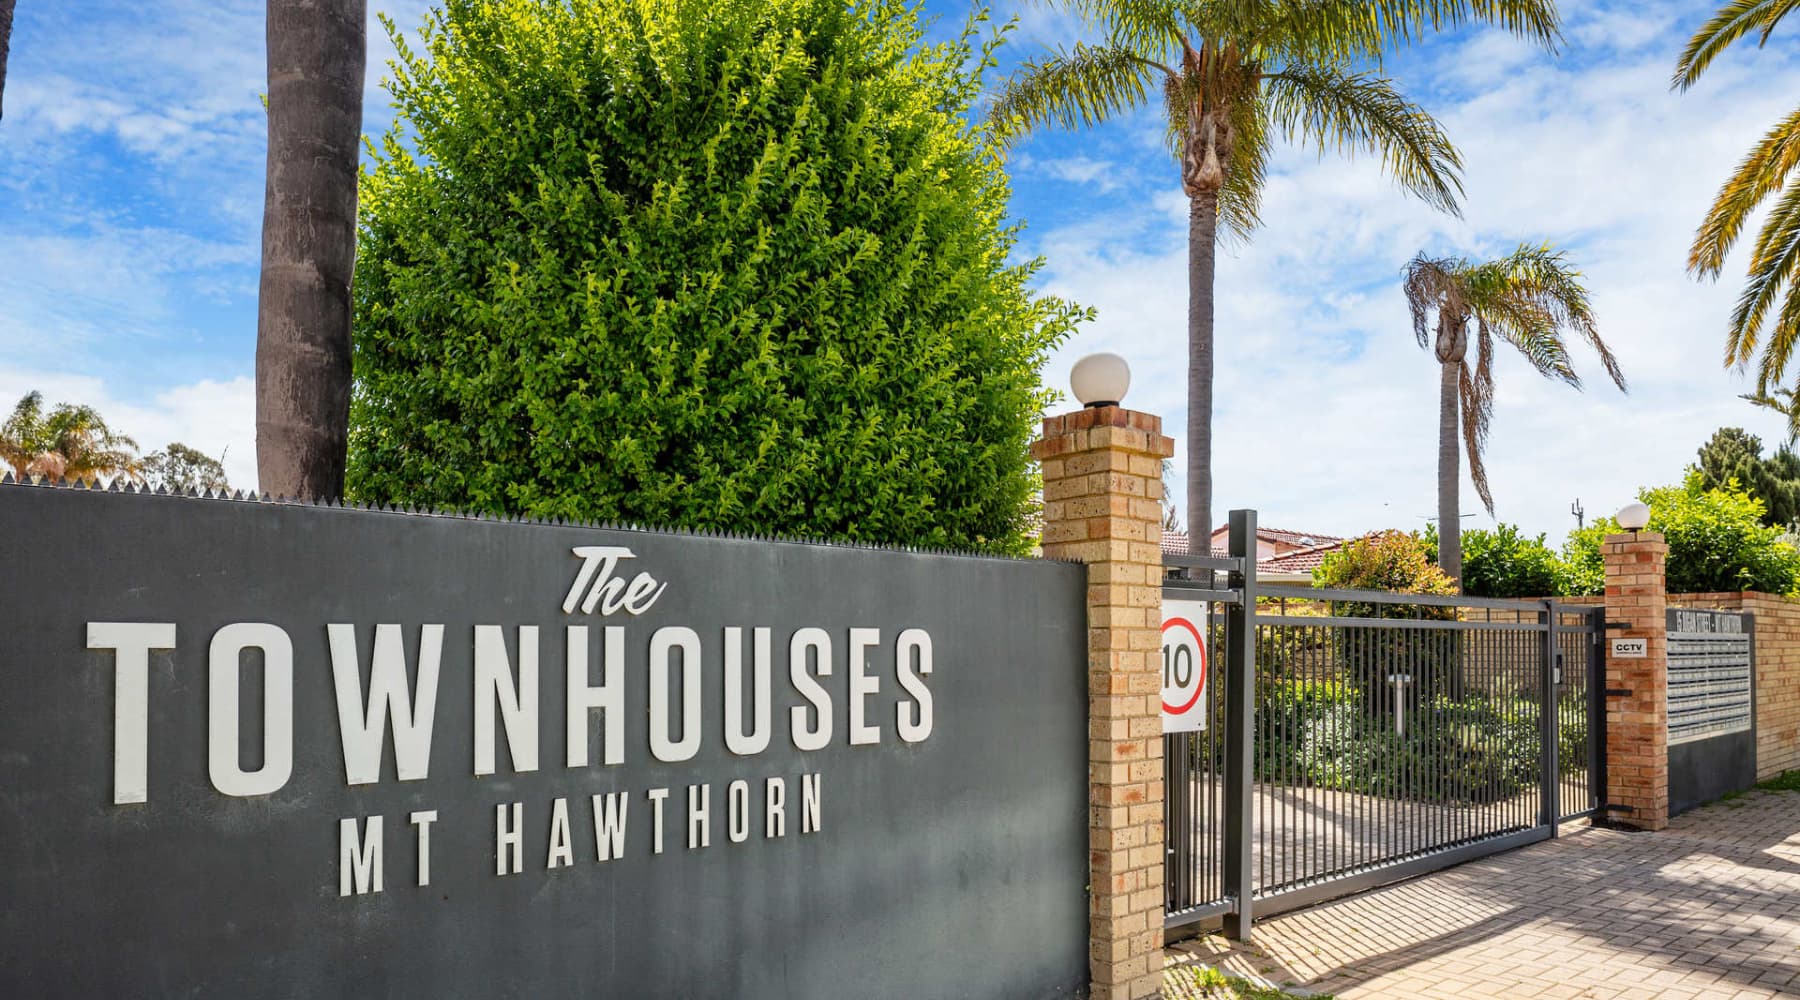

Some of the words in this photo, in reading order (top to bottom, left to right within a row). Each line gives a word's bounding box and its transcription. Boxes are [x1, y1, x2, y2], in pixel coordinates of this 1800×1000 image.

[562, 546, 667, 616] The
[87, 622, 933, 805] TOWNHOUSES
[1163, 643, 1192, 689] 10
[339, 809, 438, 897] MT
[496, 773, 821, 876] HAWTHORN
